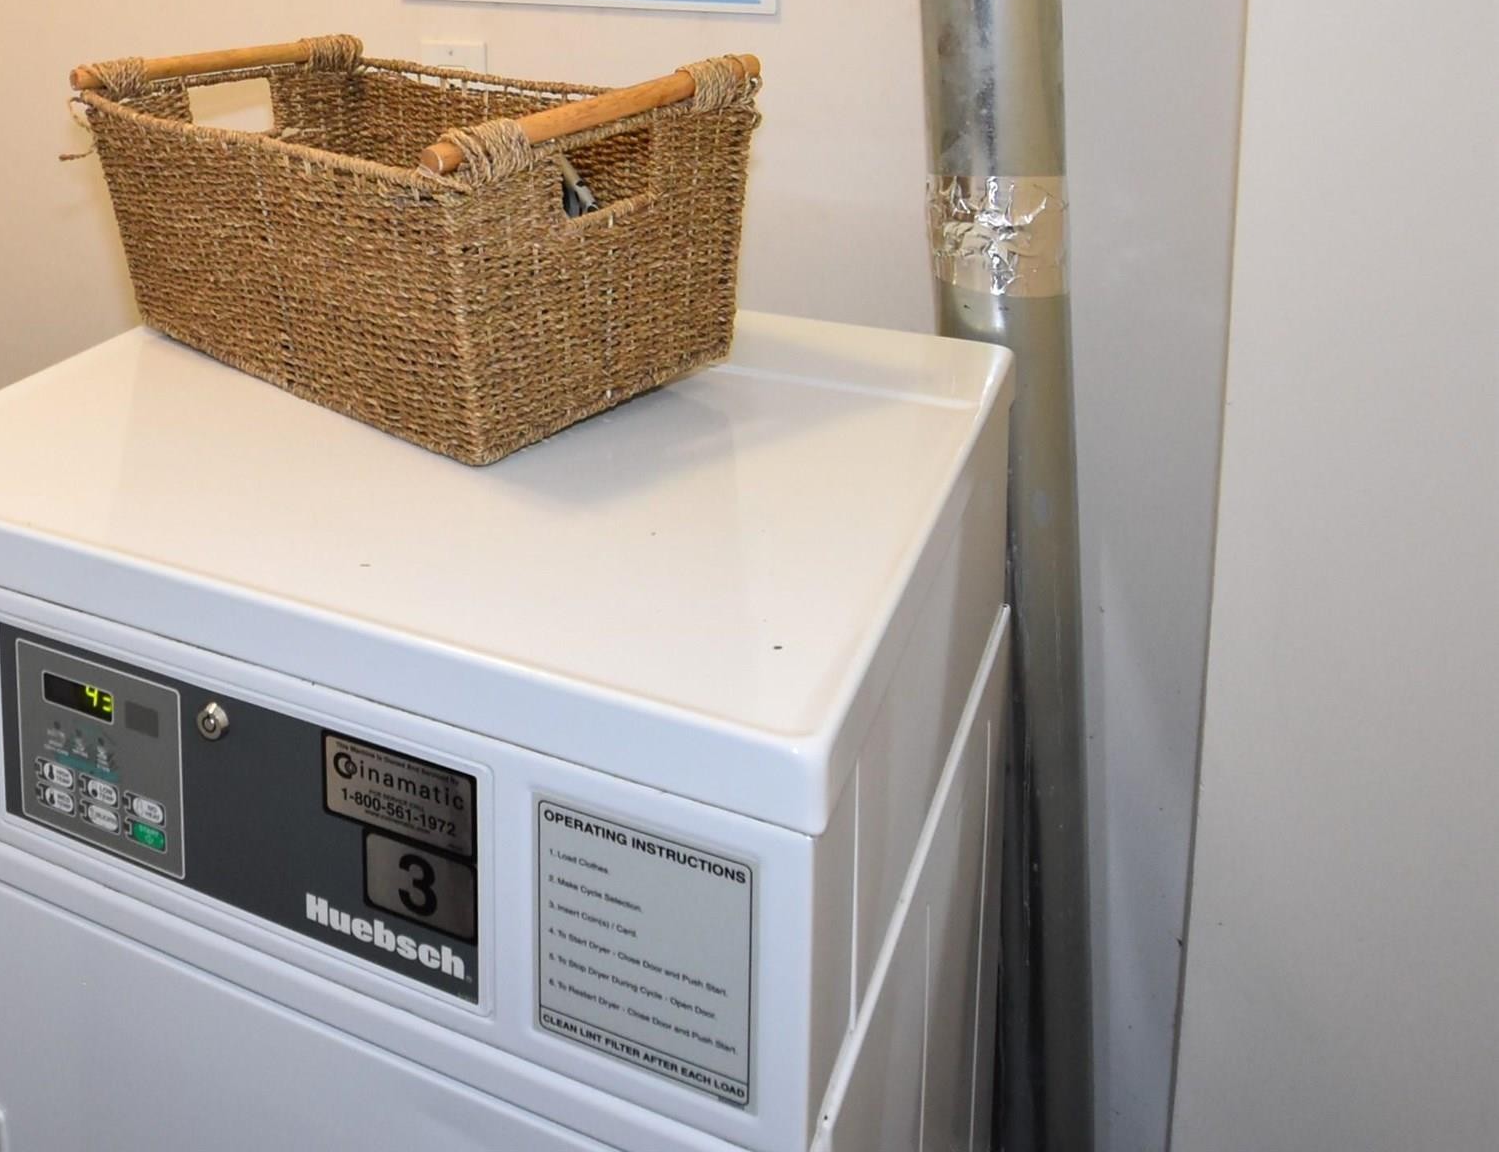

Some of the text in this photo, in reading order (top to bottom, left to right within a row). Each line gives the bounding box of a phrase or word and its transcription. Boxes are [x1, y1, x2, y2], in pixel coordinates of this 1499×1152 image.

[342, 788, 457, 837] 1-800-561-1972
[544, 809, 746, 884] OPERATING INSTRUCTIONS
[558, 851, 577, 864] Load
[398, 854, 437, 917] 3
[558, 877, 578, 890] Make
[581, 885, 602, 899] Cycle
[305, 892, 465, 980] Huebsch
[558, 904, 579, 918] Insert
[582, 912, 609, 929] Coin(s)
[557, 929, 566, 939] To
[569, 933, 587, 946] Start
[589, 941, 610, 954] Dryer
[618, 951, 640, 965] Close
[643, 960, 662, 973] Door
[665, 969, 680, 980] and
[682, 974, 703, 988] Push
[558, 955, 567, 965] To
[569, 959, 586, 973] Stop
[588, 966, 609, 980] Dryer
[612, 975, 638, 992] During
[640, 986, 662, 1000] Cycle
[670, 997, 692, 1011] Open
[558, 981, 567, 991] To
[568, 984, 596, 1002] Restart
[598, 996, 619, 1009] Dryer
[627, 1007, 650, 1022] Close
[652, 1016, 672, 1029] Door
[674, 1026, 690, 1037] and
[692, 1031, 713, 1045] Push
[543, 1013, 745, 1098] CLEAN LINT FILTER AFTER EACH LOAD
